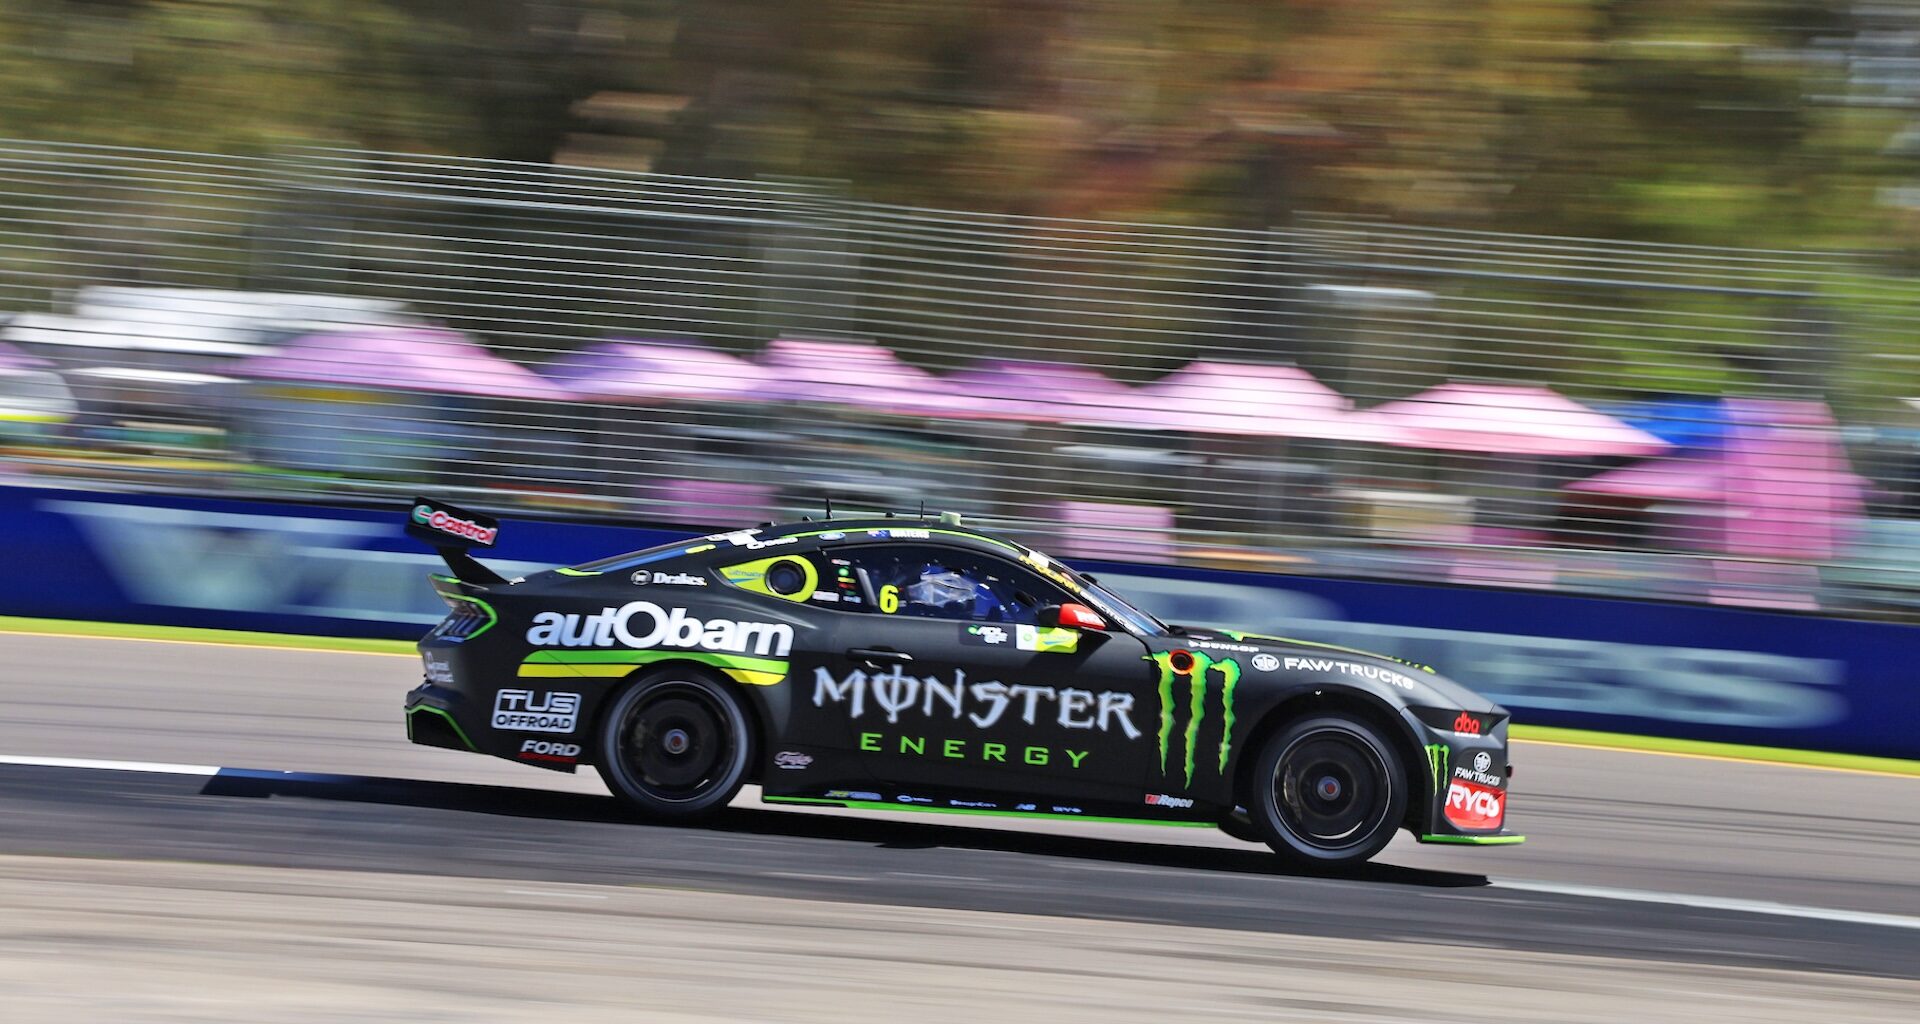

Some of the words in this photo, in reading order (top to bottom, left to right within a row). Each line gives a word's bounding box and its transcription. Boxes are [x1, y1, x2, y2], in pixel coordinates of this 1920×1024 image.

[429, 511, 498, 545] Castrol
[880, 585, 899, 614] 6
[1200, 642, 1259, 653] DUNLOP
[1284, 657, 1335, 672] FAW
[1338, 661, 1414, 690] TRUCKS
[501, 690, 575, 713] TUS
[812, 664, 1141, 740] MONSTER
[496, 714, 571, 729] OFFROAD
[521, 740, 581, 757] FORD
[860, 732, 1089, 768] ENERGY
[1455, 766, 1474, 780] FAW
[1158, 794, 1194, 808] Repco
